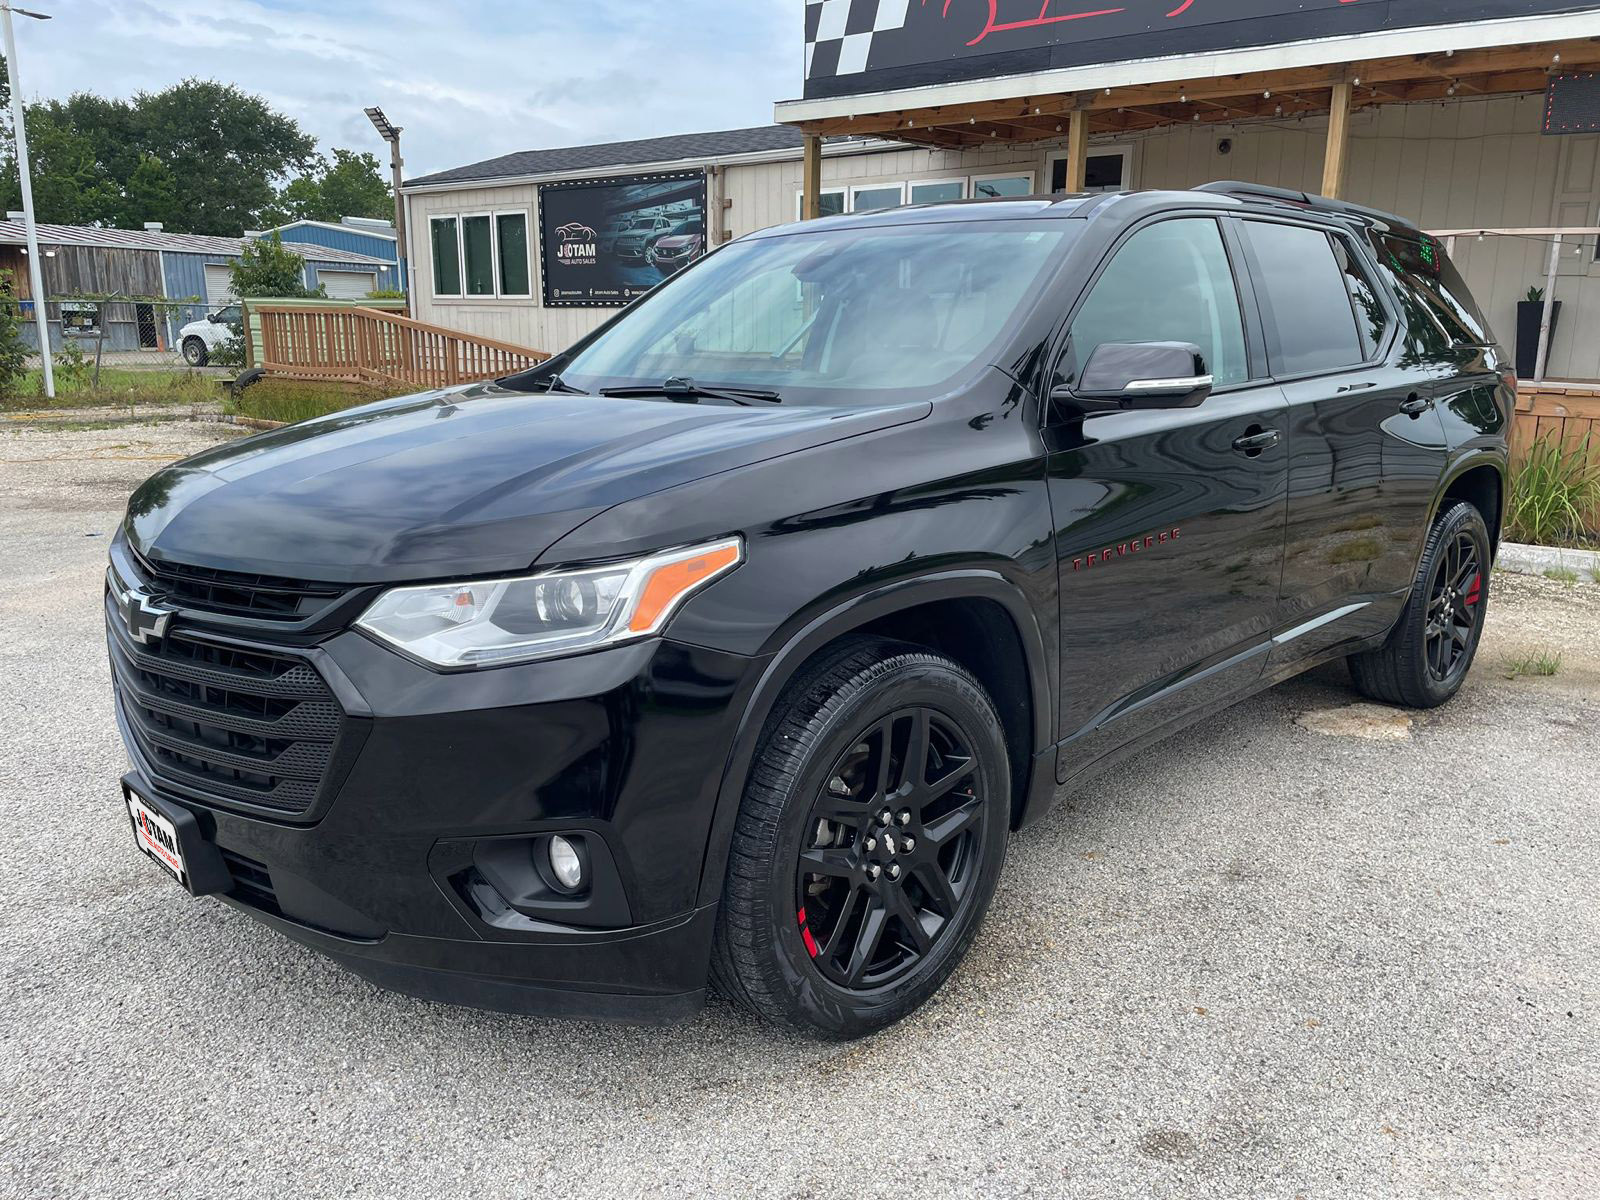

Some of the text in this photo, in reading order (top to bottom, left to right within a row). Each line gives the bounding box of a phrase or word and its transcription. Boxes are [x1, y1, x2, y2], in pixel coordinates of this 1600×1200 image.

[557, 243, 596, 257] JOTAM
[583, 257, 596, 265] SALES
[136, 808, 176, 855] JOTAM
